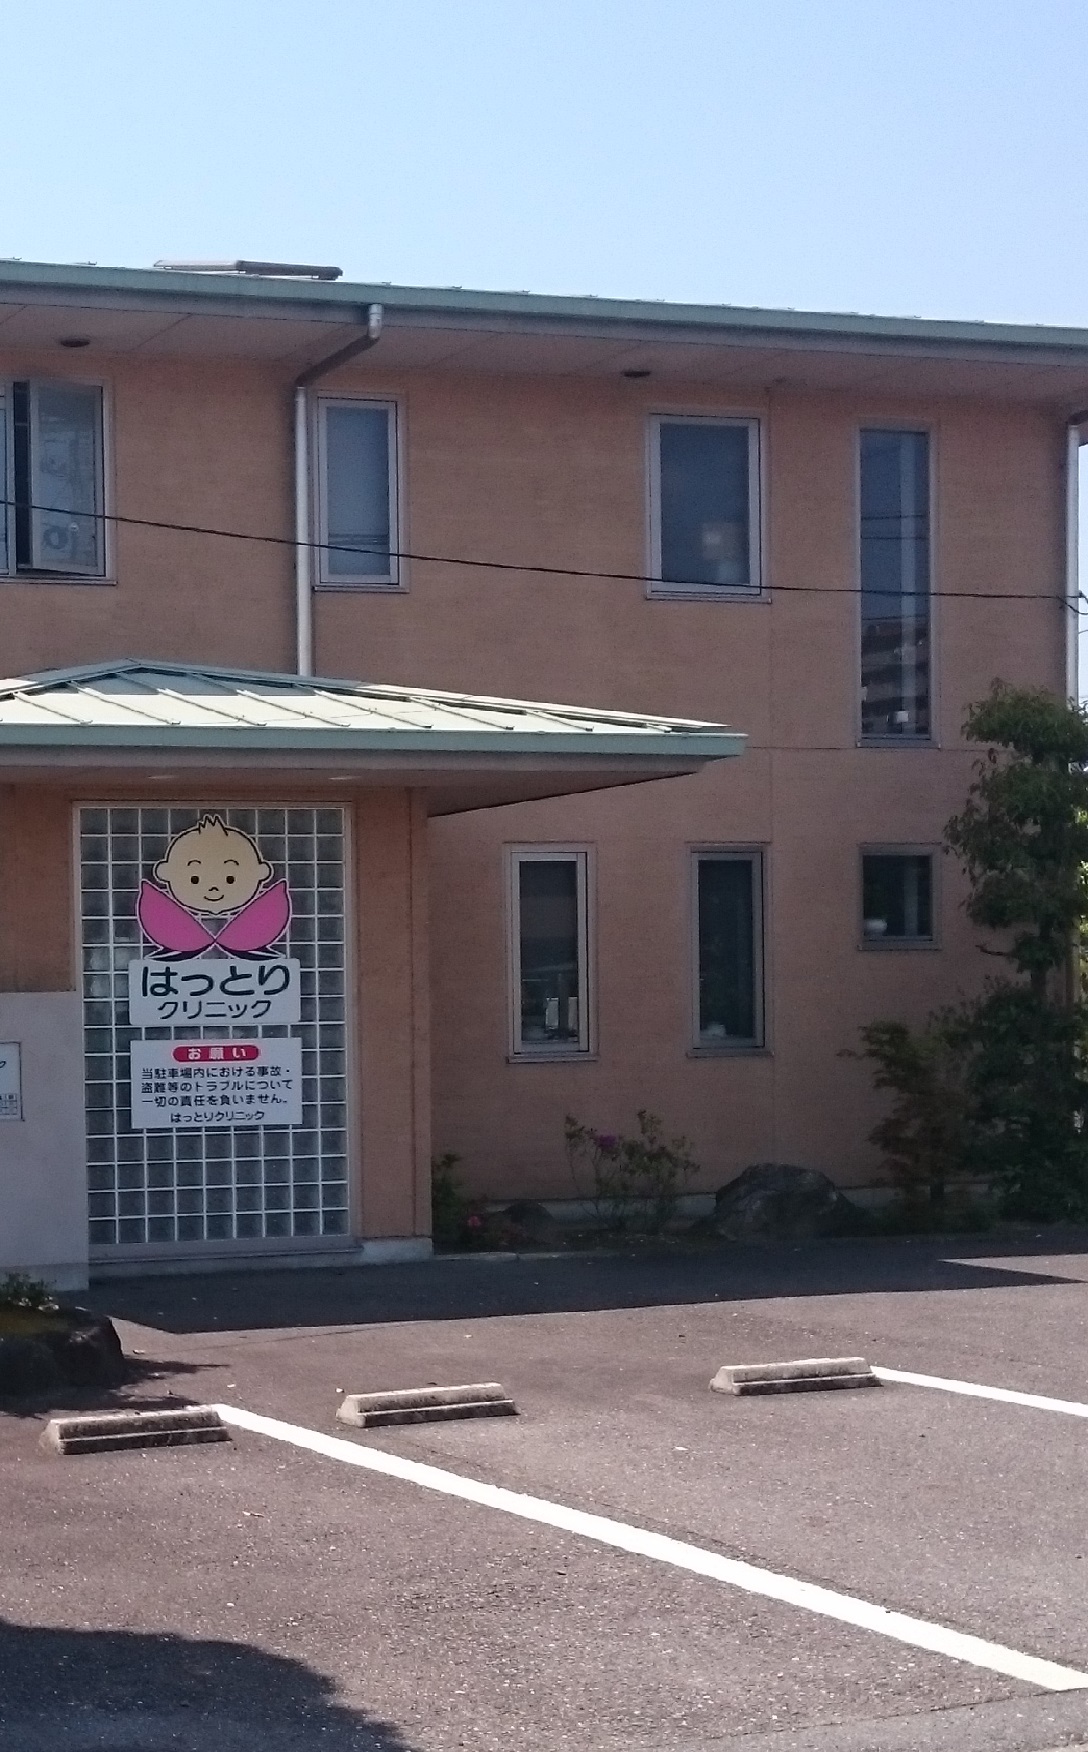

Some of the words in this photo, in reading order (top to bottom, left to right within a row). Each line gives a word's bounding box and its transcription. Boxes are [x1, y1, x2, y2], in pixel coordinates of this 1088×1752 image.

[141, 964, 290, 997] はっとり
[157, 1000, 271, 1019] クリニック
[187, 1047, 247, 1061] お願い
[141, 1079, 293, 1094] 盗難等のトラブルについて
[170, 1110, 265, 1123] はっとりクリニック
